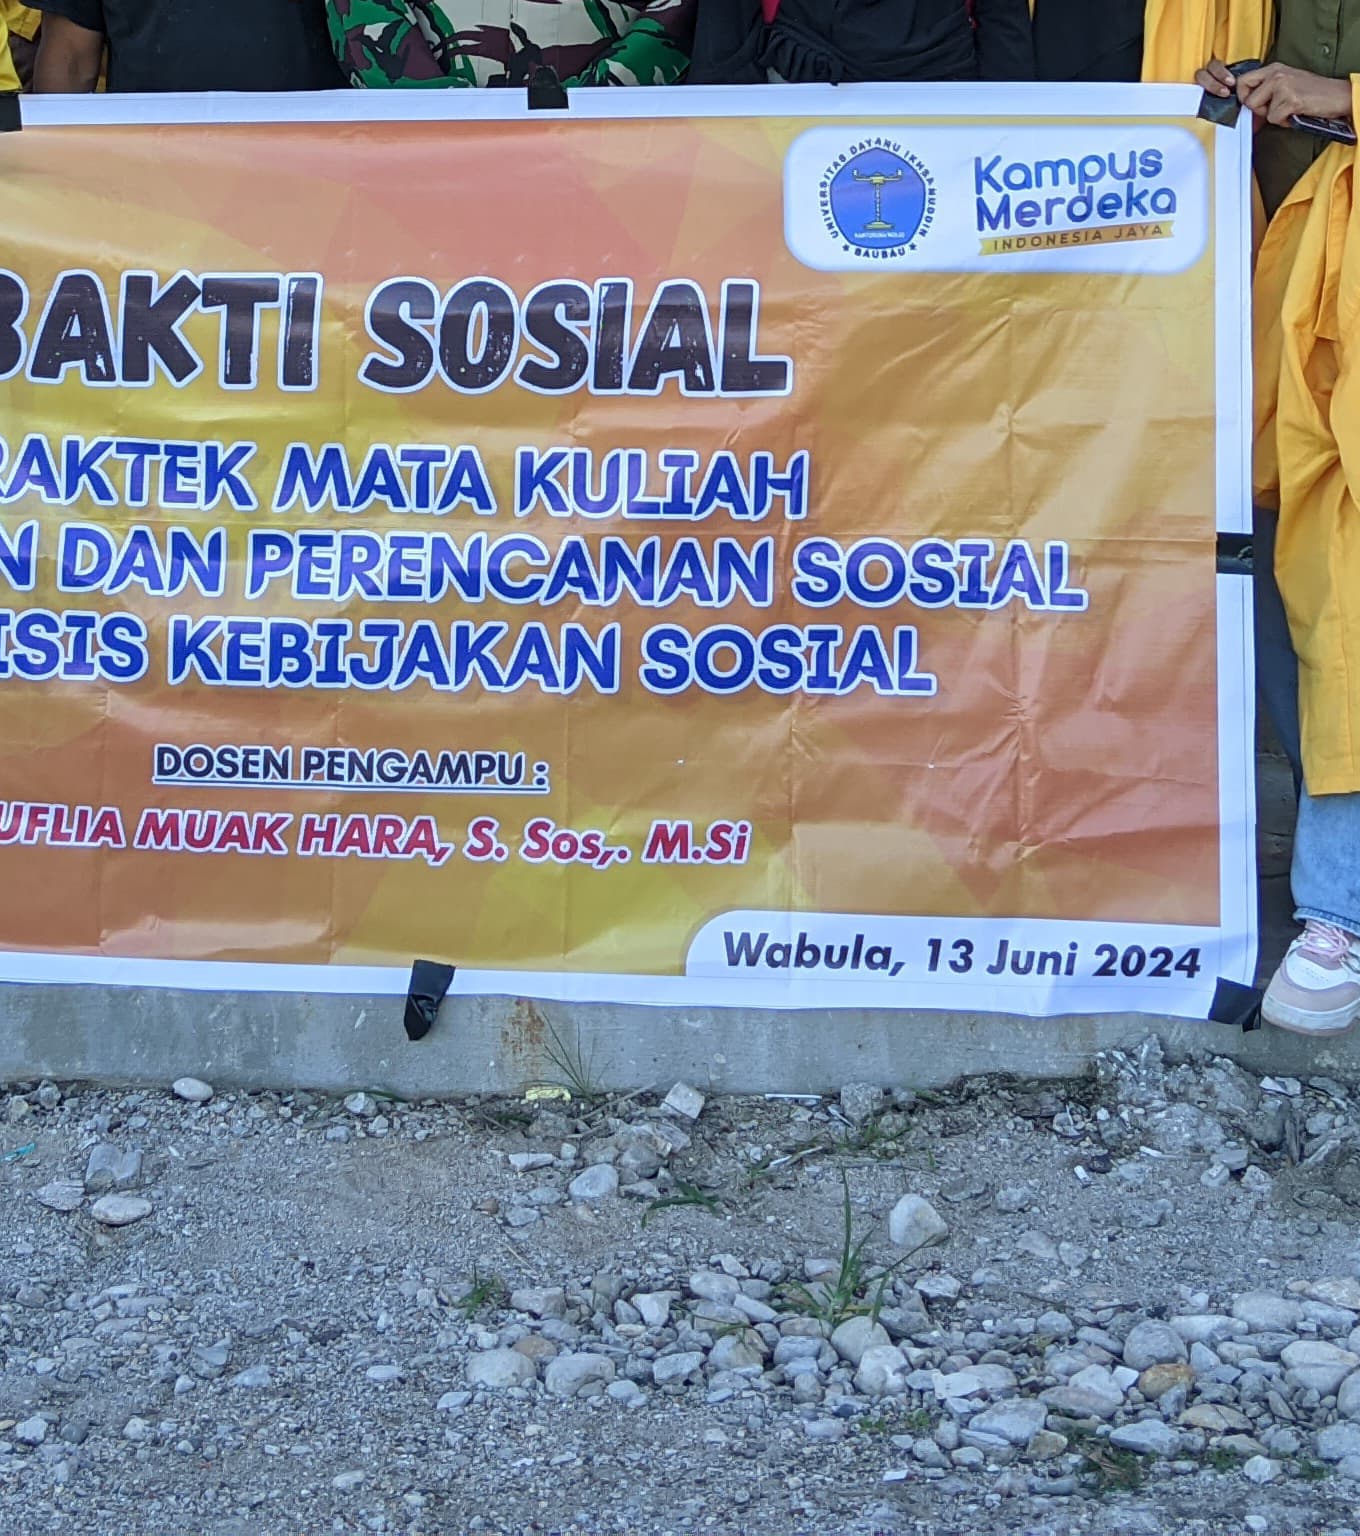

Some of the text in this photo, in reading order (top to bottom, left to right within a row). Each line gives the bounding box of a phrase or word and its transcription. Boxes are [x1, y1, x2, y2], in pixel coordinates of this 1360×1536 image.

[819, 137, 938, 240] UNIVERSITAS DAYANU IKHSANUDDIN
[974, 148, 1164, 196] Kampus
[975, 181, 1177, 232] Merdeka
[853, 246, 907, 260] BAUBAU
[993, 224, 1163, 252] INDONESIA JAYA
[360, 278, 790, 395] SOSIAL
[274, 443, 495, 513] MATA
[516, 447, 807, 519] KULIAH
[59, 522, 223, 597] DAN
[248, 528, 772, 606] PERENCANAN
[794, 538, 1086, 609] SOSIAL
[170, 617, 620, 693] KEBIJAKAN
[642, 624, 935, 694] SOSIAL
[156, 745, 291, 780] DOSEN
[303, 747, 525, 785] PENGAMPU
[136, 810, 292, 854] MUAK
[298, 814, 453, 865] HARA,
[465, 817, 507, 859] S.
[644, 821, 751, 863] M.Si
[723, 930, 1202, 979] Wabula, 13 Juni 2024
